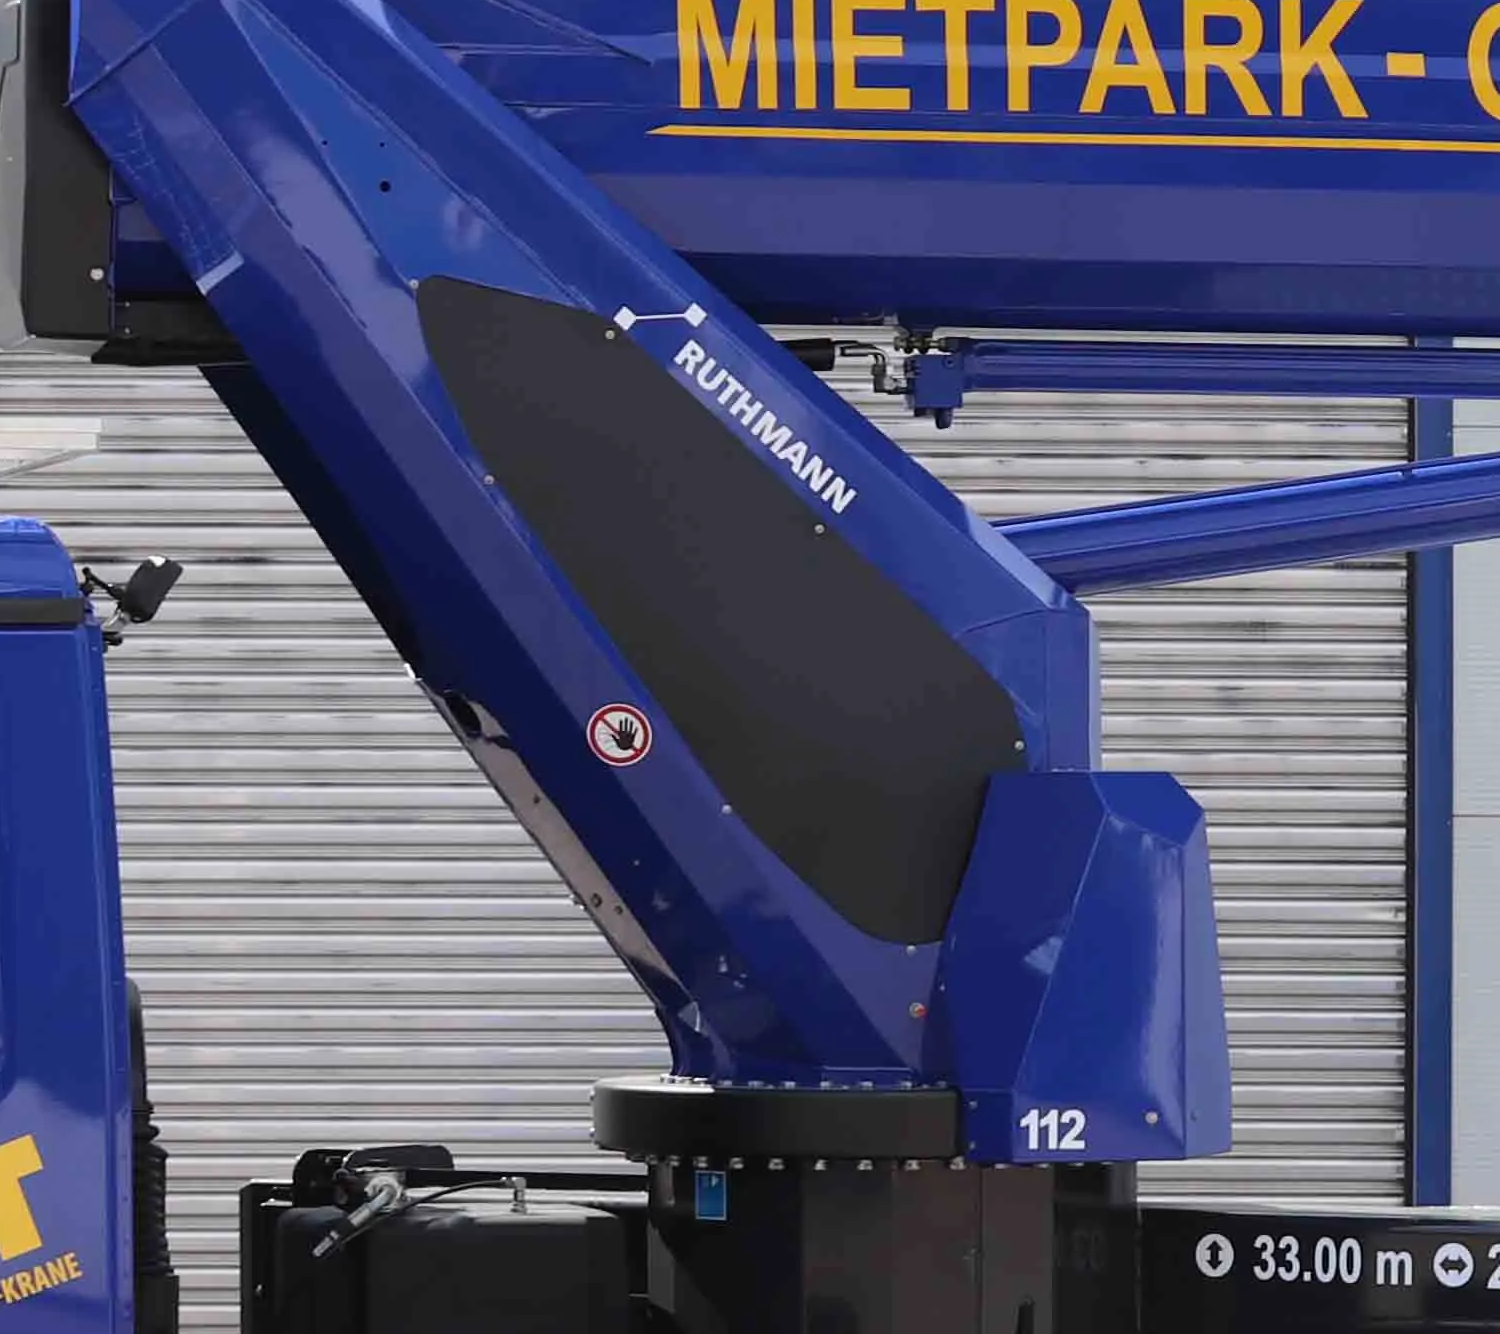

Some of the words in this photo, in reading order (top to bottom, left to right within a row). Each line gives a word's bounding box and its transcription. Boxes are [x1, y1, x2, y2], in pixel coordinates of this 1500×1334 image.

[673, 339, 857, 514] RUTHMANN
[1019, 1108, 1086, 1150] 112
[1252, 1235, 1362, 1284] 33.00
[1375, 1247, 1413, 1285] m
